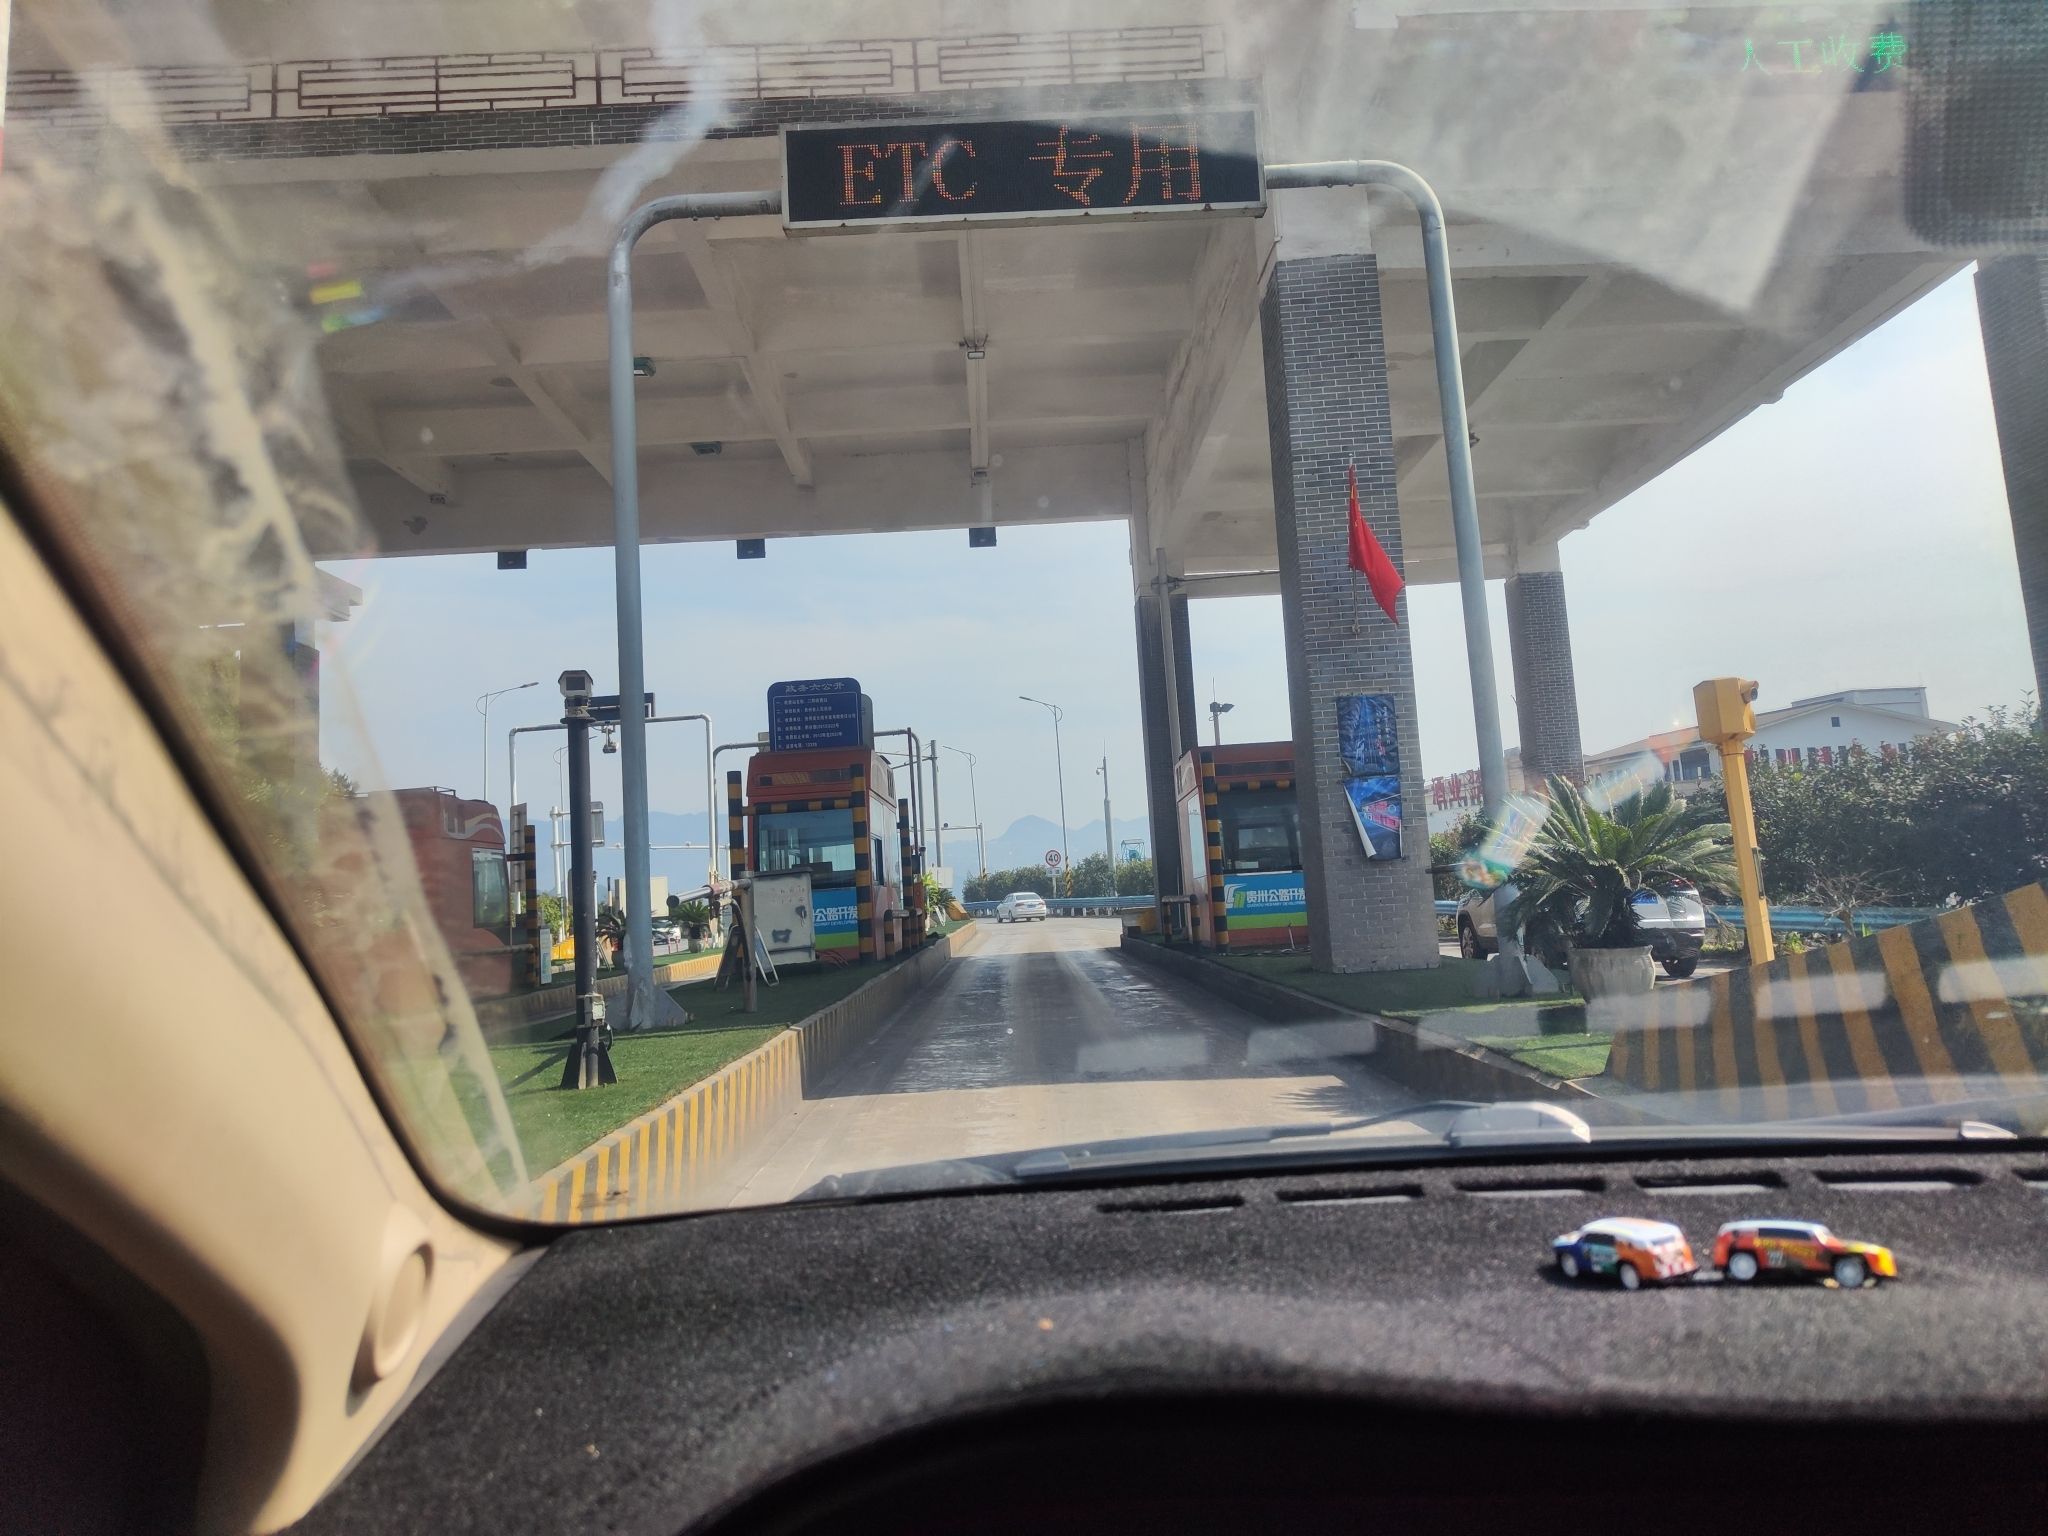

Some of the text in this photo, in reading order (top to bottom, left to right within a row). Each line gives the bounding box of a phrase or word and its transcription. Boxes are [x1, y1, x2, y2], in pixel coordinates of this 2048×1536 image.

[1740, 32, 1908, 75] 人工收费
[836, 122, 1200, 206] ETC 专用
